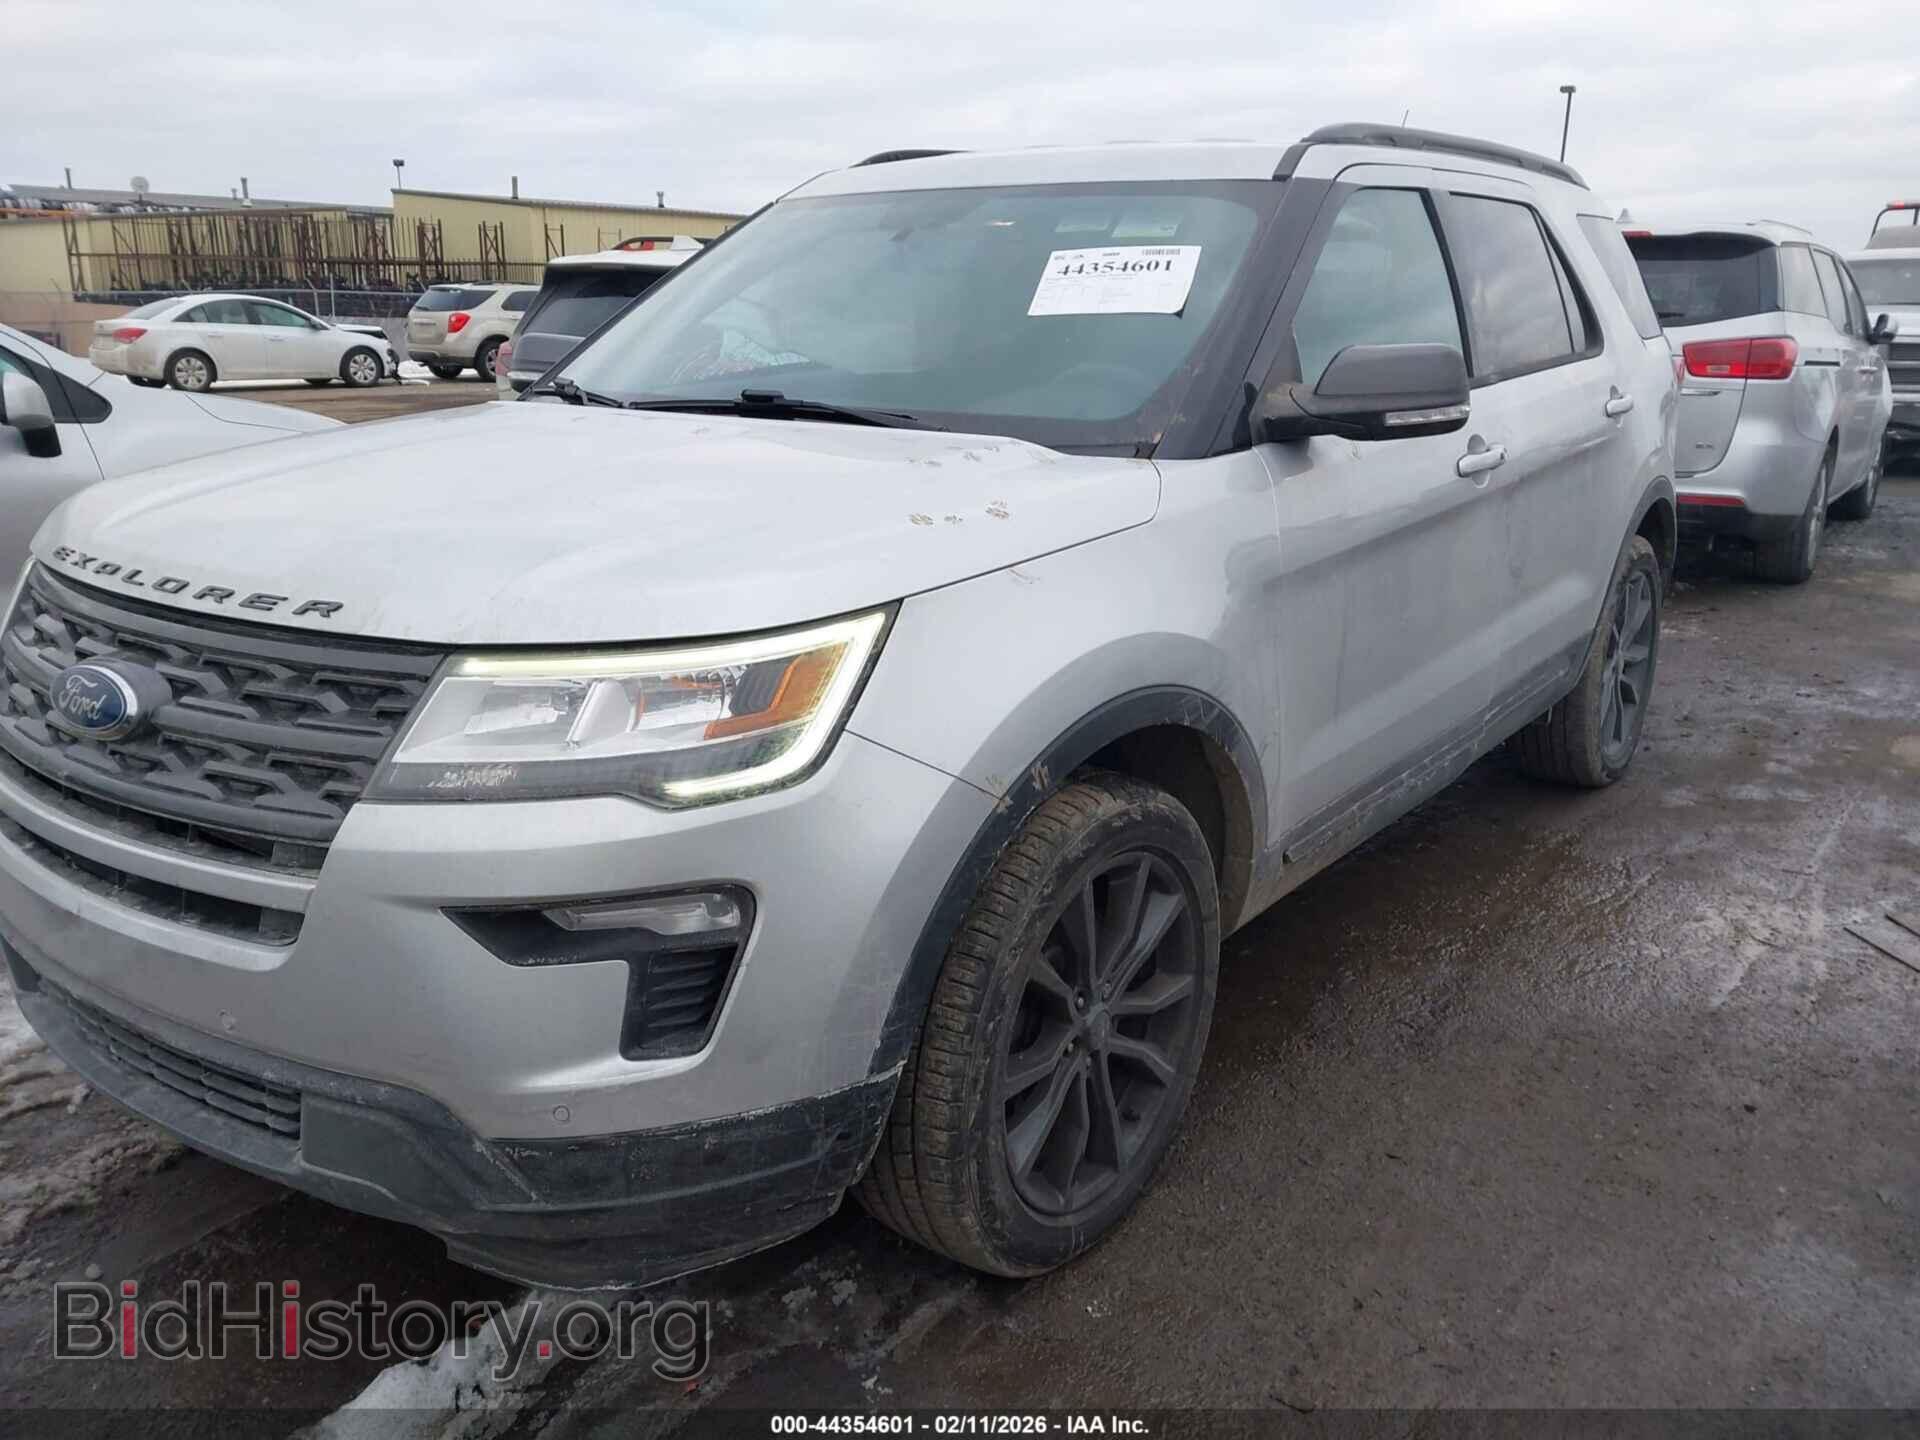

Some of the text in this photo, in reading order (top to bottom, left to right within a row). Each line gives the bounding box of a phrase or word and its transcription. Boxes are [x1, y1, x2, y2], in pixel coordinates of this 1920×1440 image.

[1056, 259, 1173, 276] 44354601
[52, 545, 344, 618] EXPLORER
[58, 674, 107, 721] Ford
